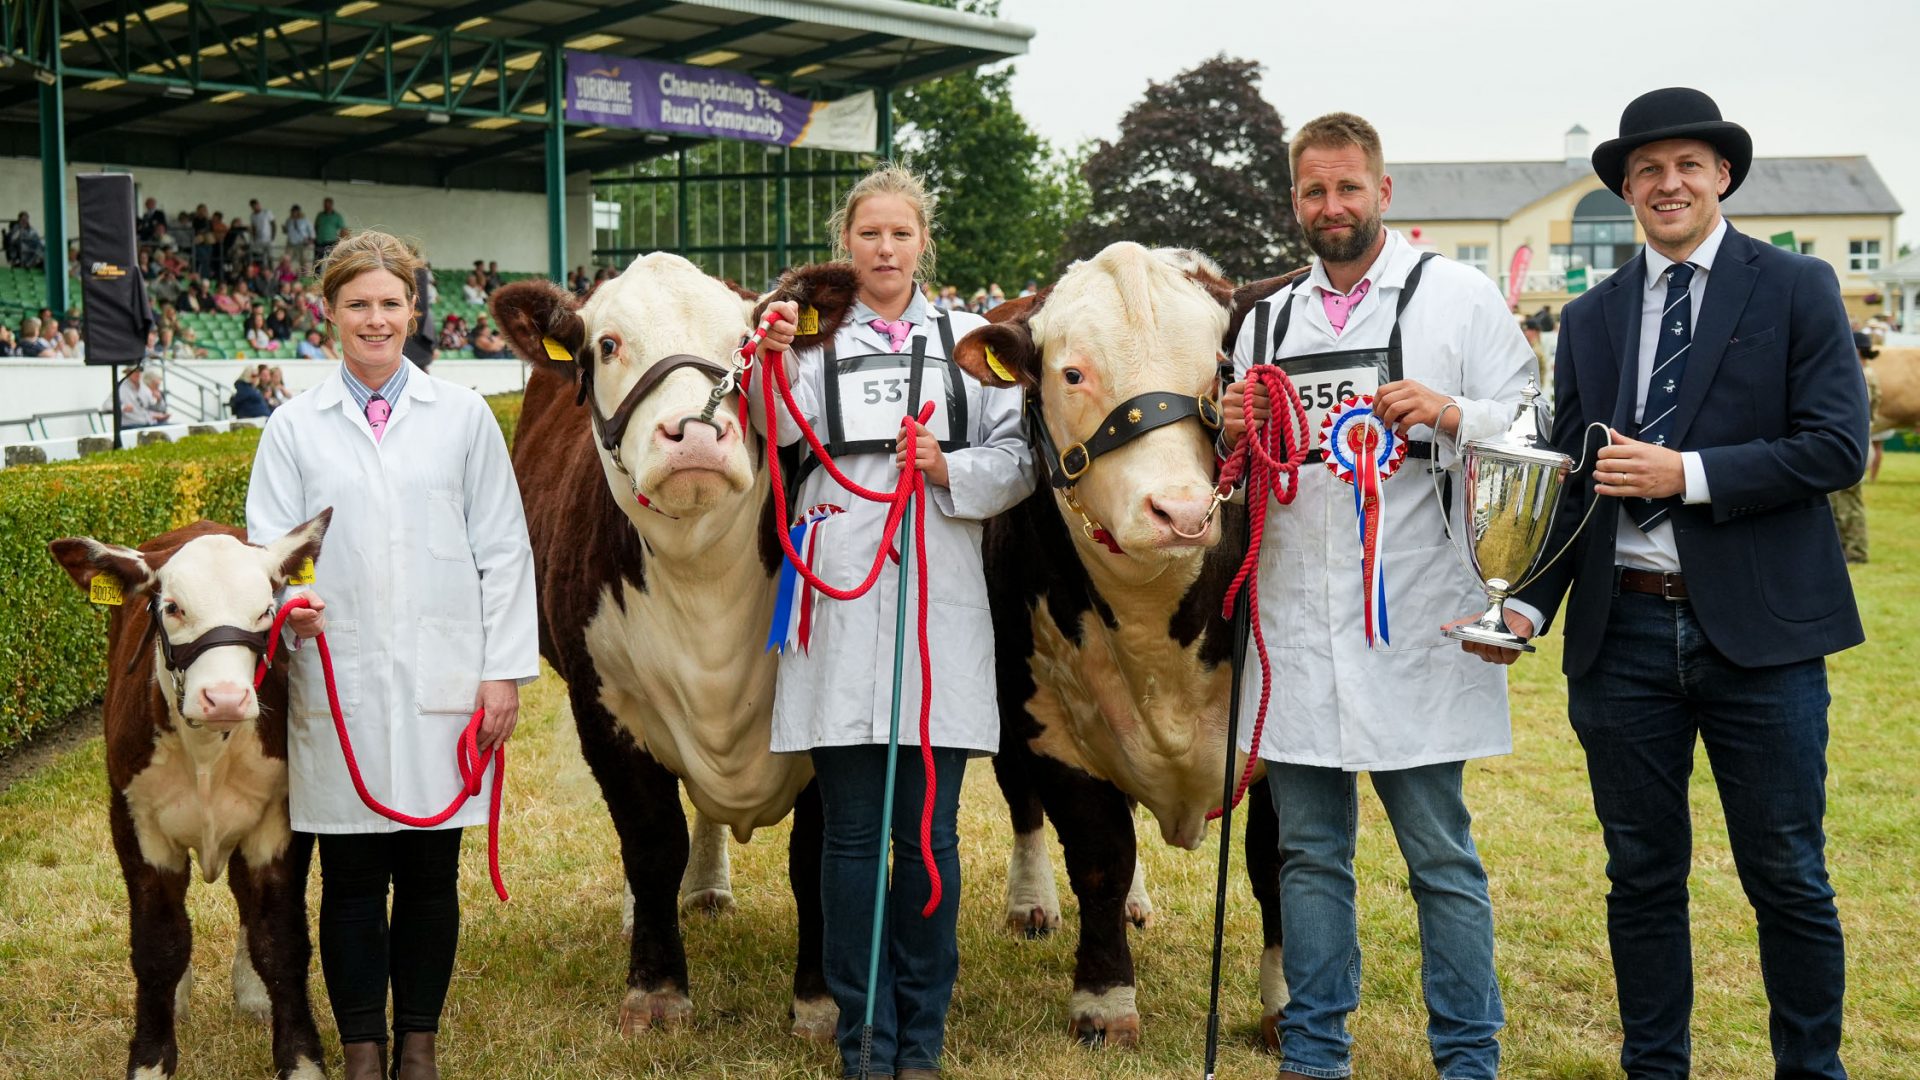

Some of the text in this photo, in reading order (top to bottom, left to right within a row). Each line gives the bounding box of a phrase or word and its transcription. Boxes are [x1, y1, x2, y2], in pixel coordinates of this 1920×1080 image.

[575, 76, 632, 103] YORKSHIRE
[659, 72, 754, 111] Championing
[755, 87, 783, 113] The
[661, 99, 701, 125] Rural
[702, 104, 783, 141] Community
[863, 378, 911, 405] 53
[1298, 380, 1356, 412] 556
[1364, 550, 1374, 577] NATIVE
